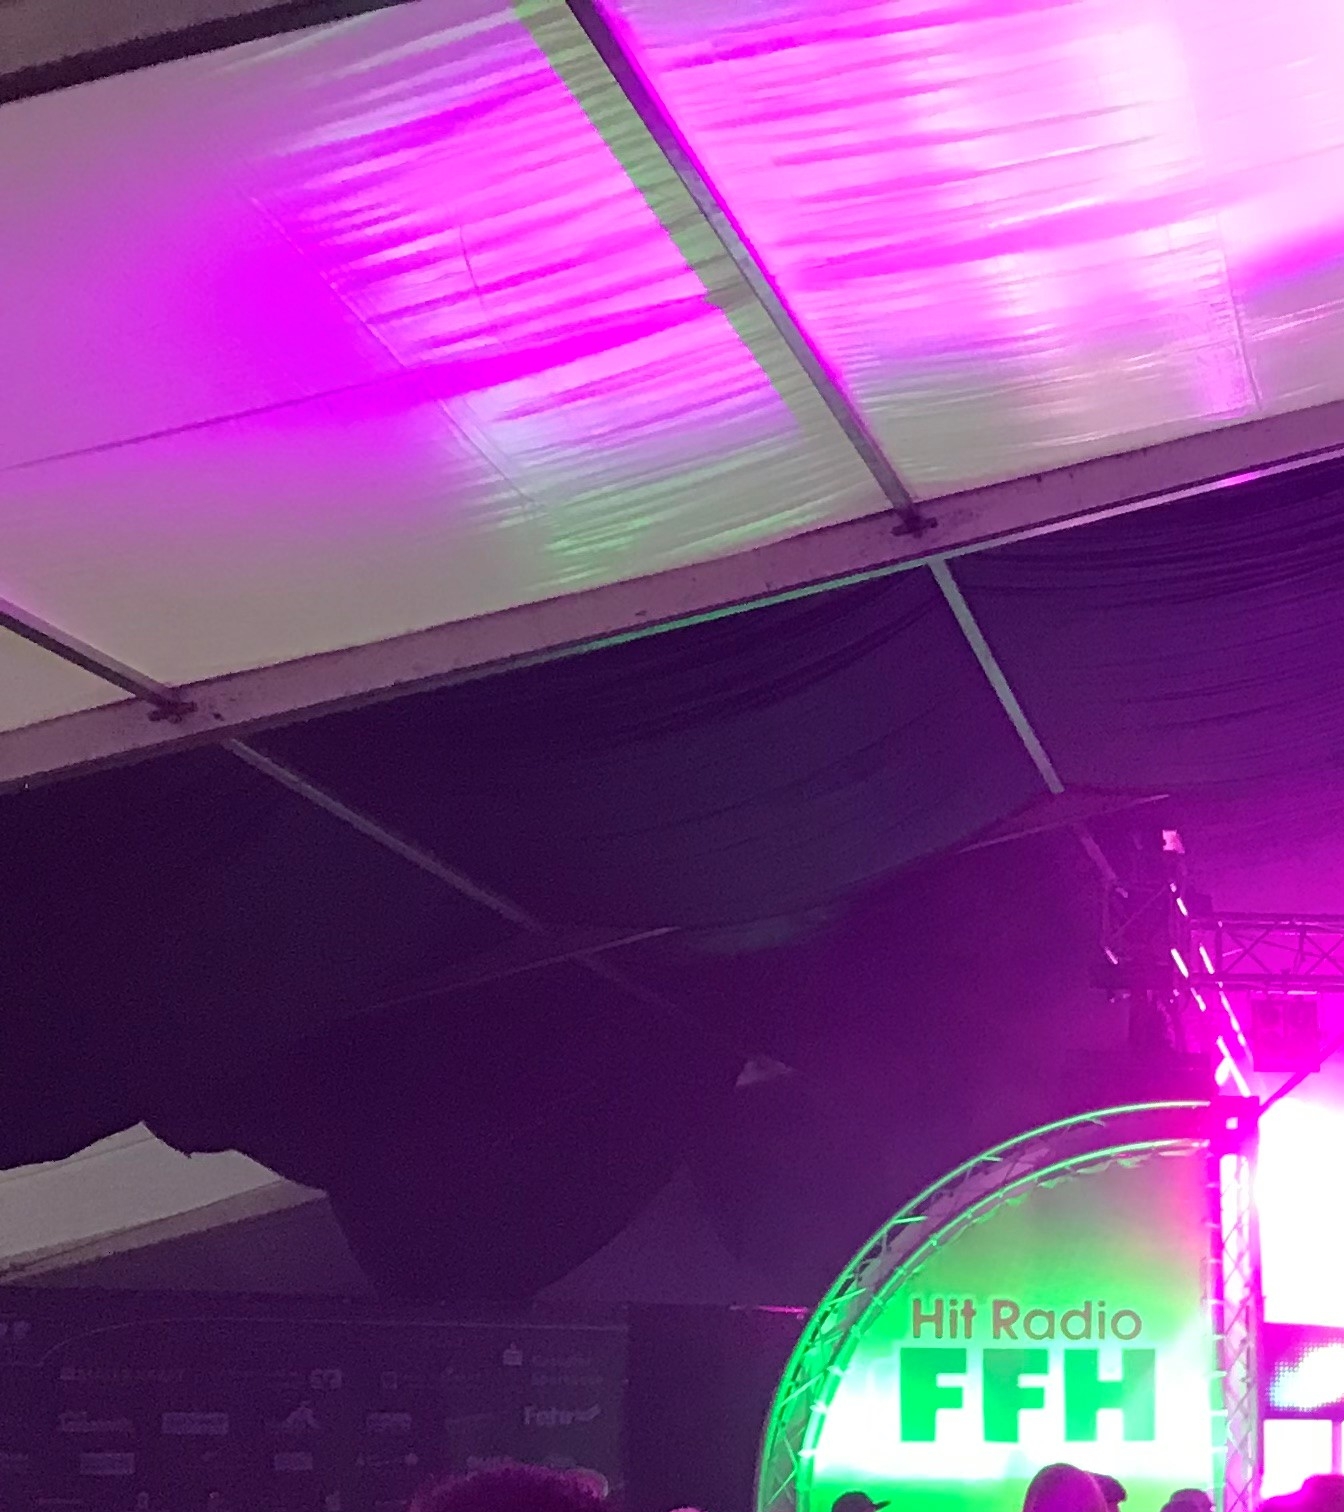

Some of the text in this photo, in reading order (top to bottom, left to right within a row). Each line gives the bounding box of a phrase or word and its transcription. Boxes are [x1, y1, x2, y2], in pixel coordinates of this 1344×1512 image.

[912, 1298, 1143, 1340] Hit Radio
[900, 1347, 1156, 1442] FFH
